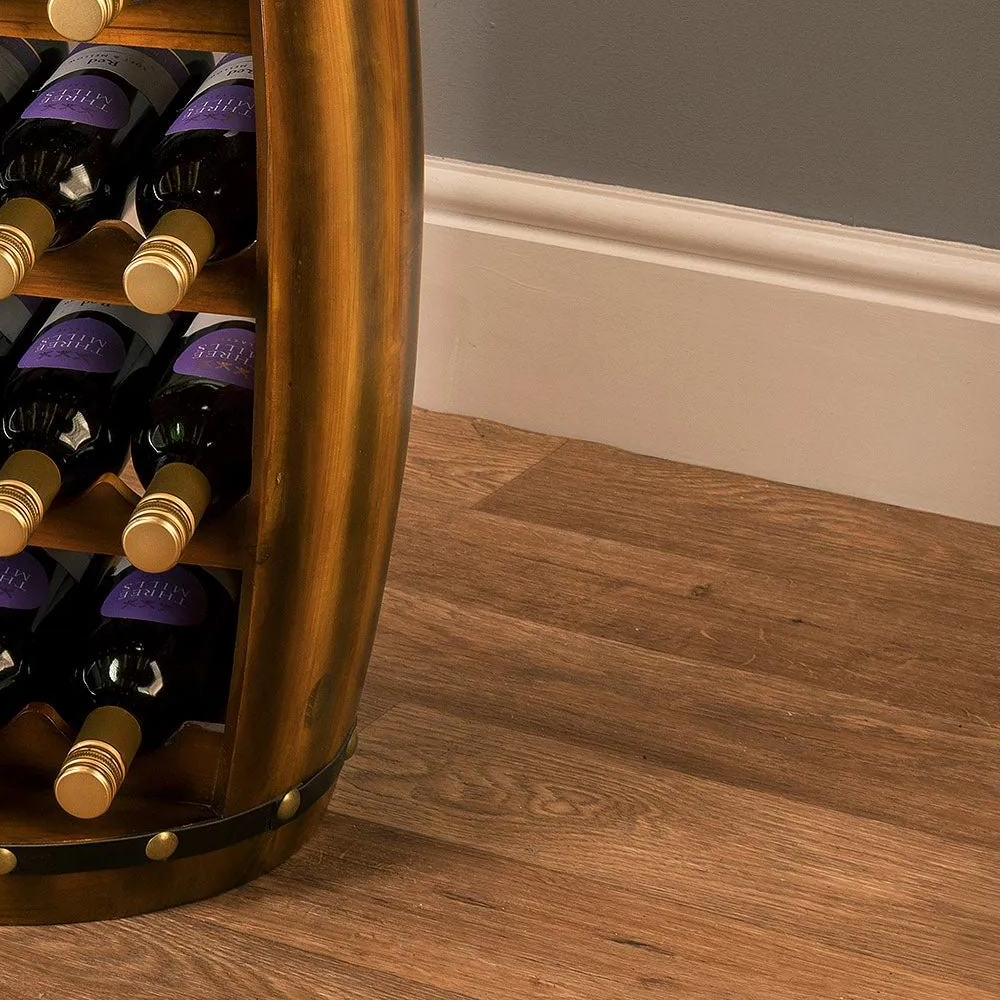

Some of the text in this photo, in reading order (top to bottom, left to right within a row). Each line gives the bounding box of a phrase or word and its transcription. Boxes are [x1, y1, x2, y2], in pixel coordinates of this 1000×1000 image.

[87, 58, 120, 67] Red
[35, 340, 104, 358] THREE
[191, 351, 250, 365] HREE
[118, 589, 187, 607] THREE
